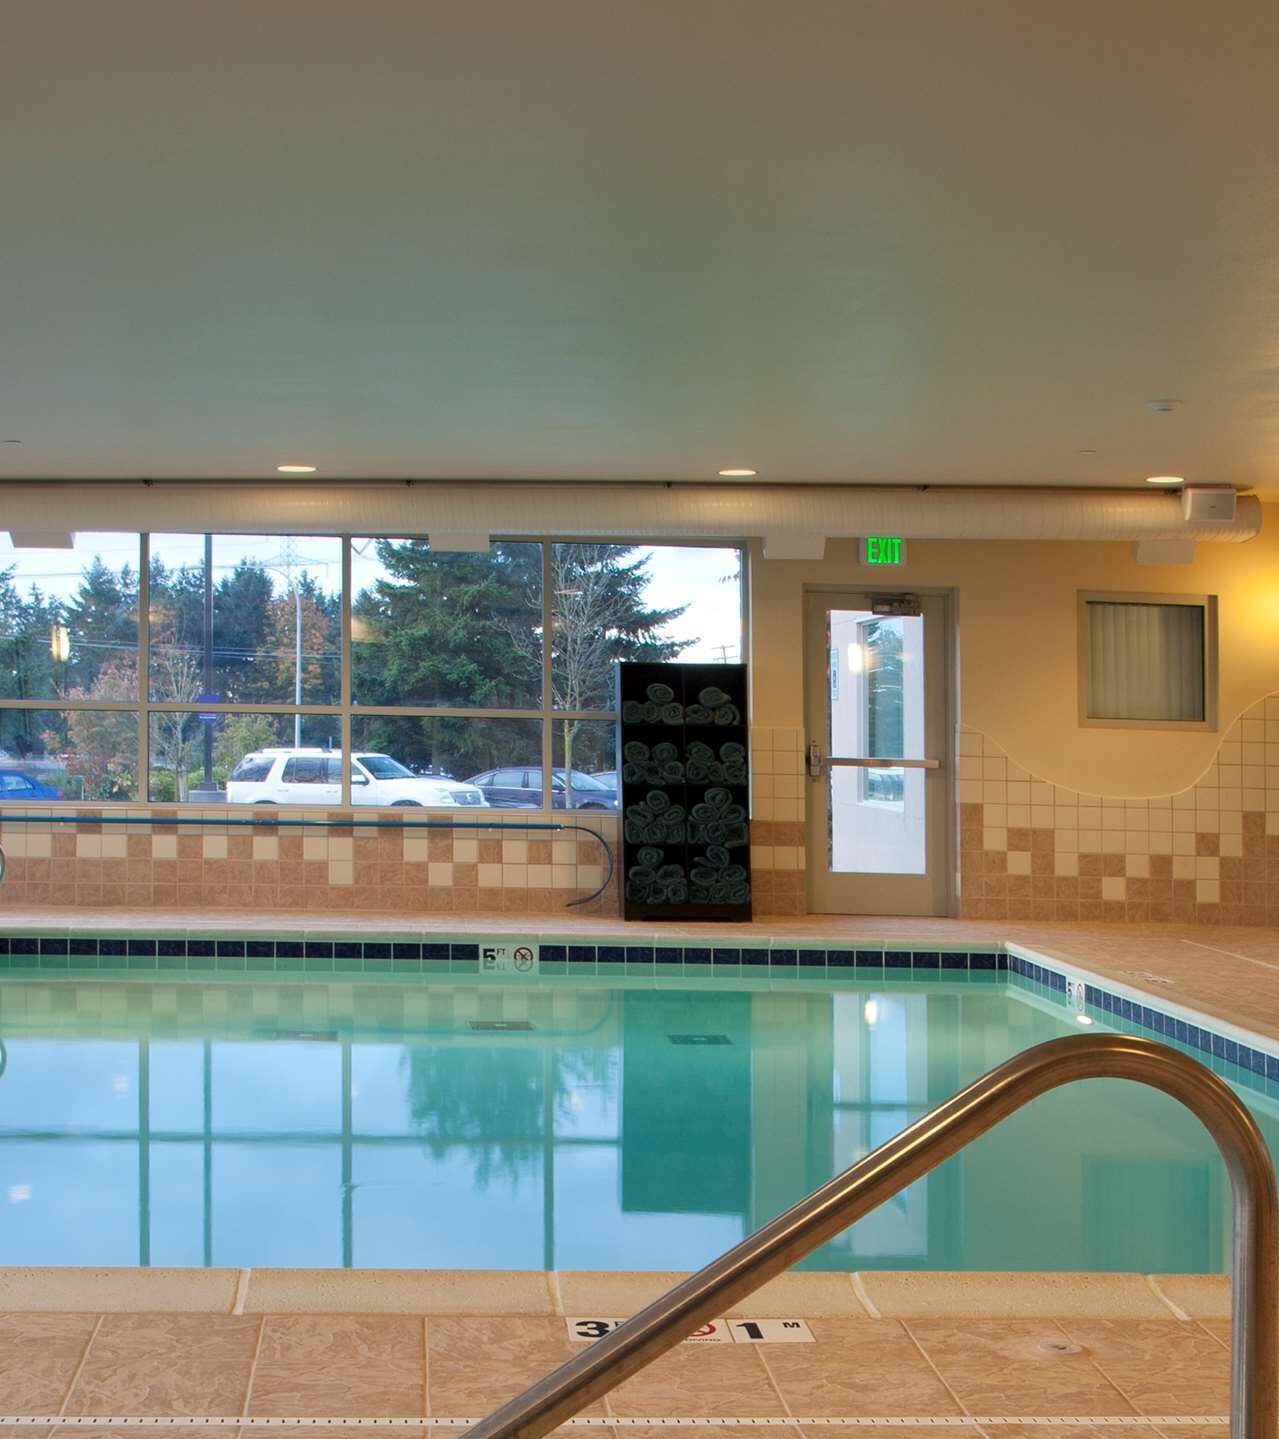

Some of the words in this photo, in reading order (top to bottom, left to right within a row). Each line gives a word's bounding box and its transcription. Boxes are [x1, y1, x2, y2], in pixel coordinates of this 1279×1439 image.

[867, 537, 901, 564] EXIT
[575, 1321, 609, 1338] 3
[736, 1322, 763, 1339] 1
